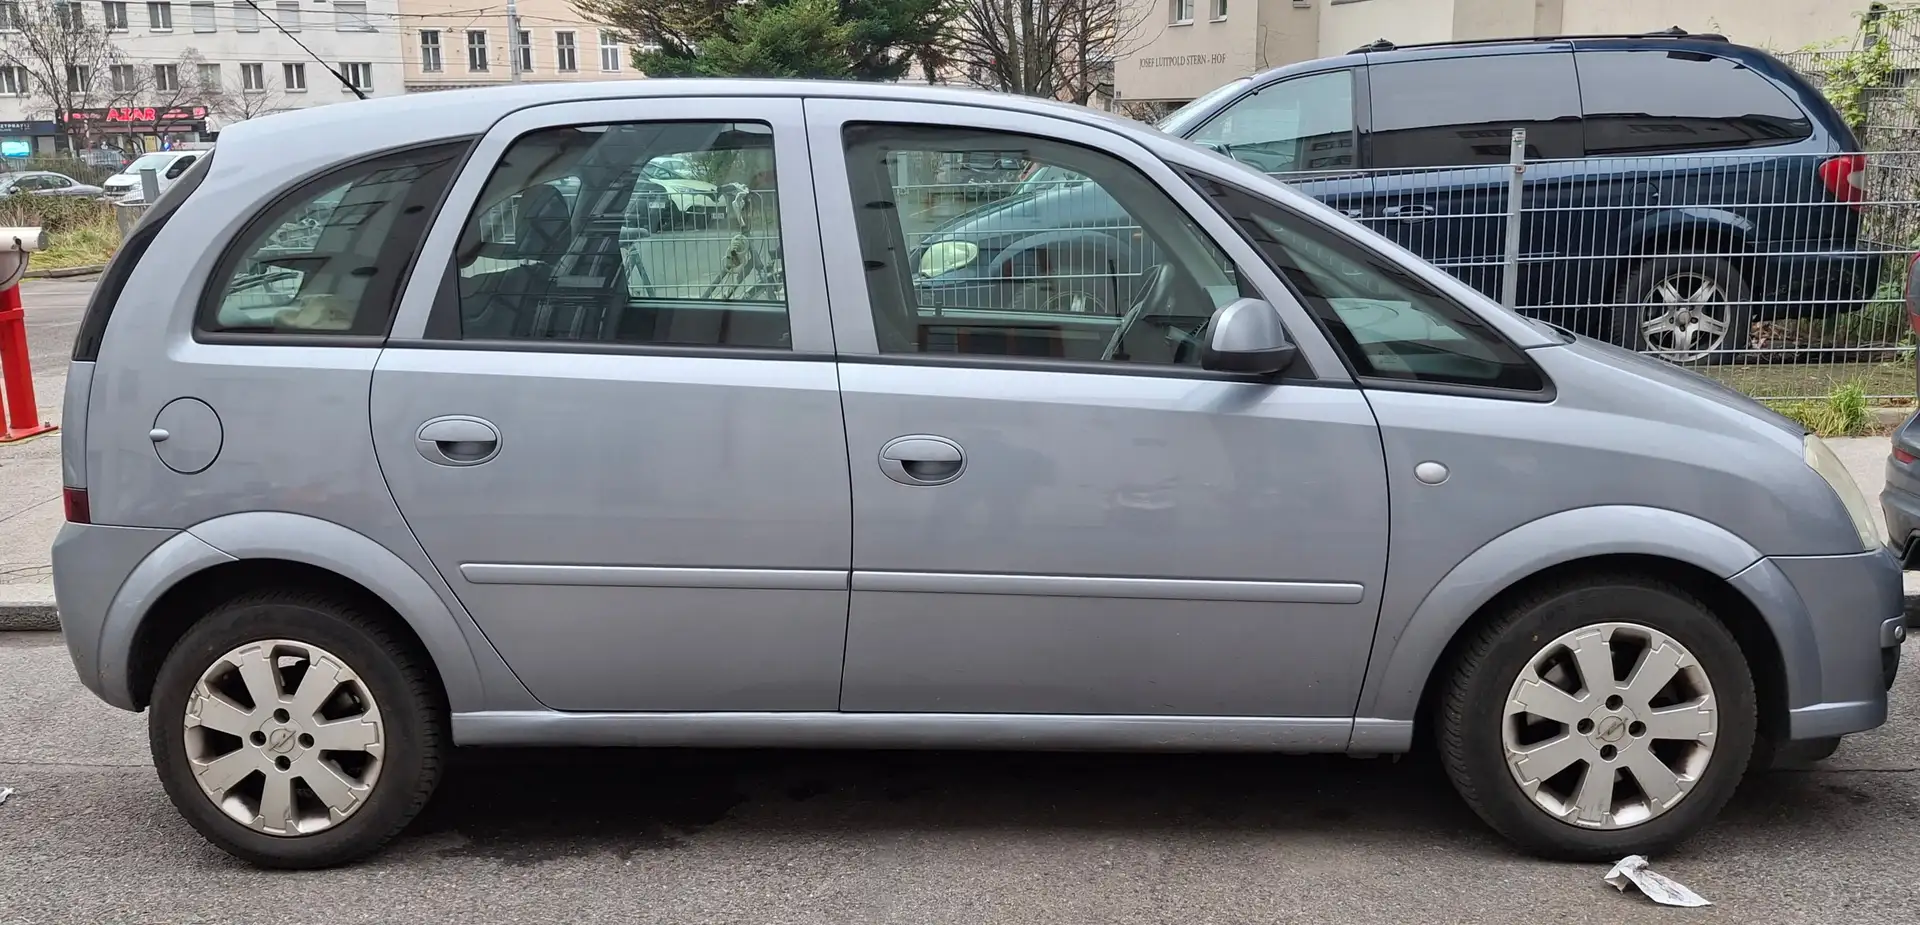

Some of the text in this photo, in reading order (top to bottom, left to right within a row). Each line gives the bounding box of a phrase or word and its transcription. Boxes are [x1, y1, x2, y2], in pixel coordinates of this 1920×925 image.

[1139, 57, 1154, 70] JOSEF
[1155, 56, 1185, 67] LUITPOLD
[1186, 54, 1206, 65] STERN
[1211, 53, 1225, 64] HOF
[106, 107, 156, 121] AZAR
